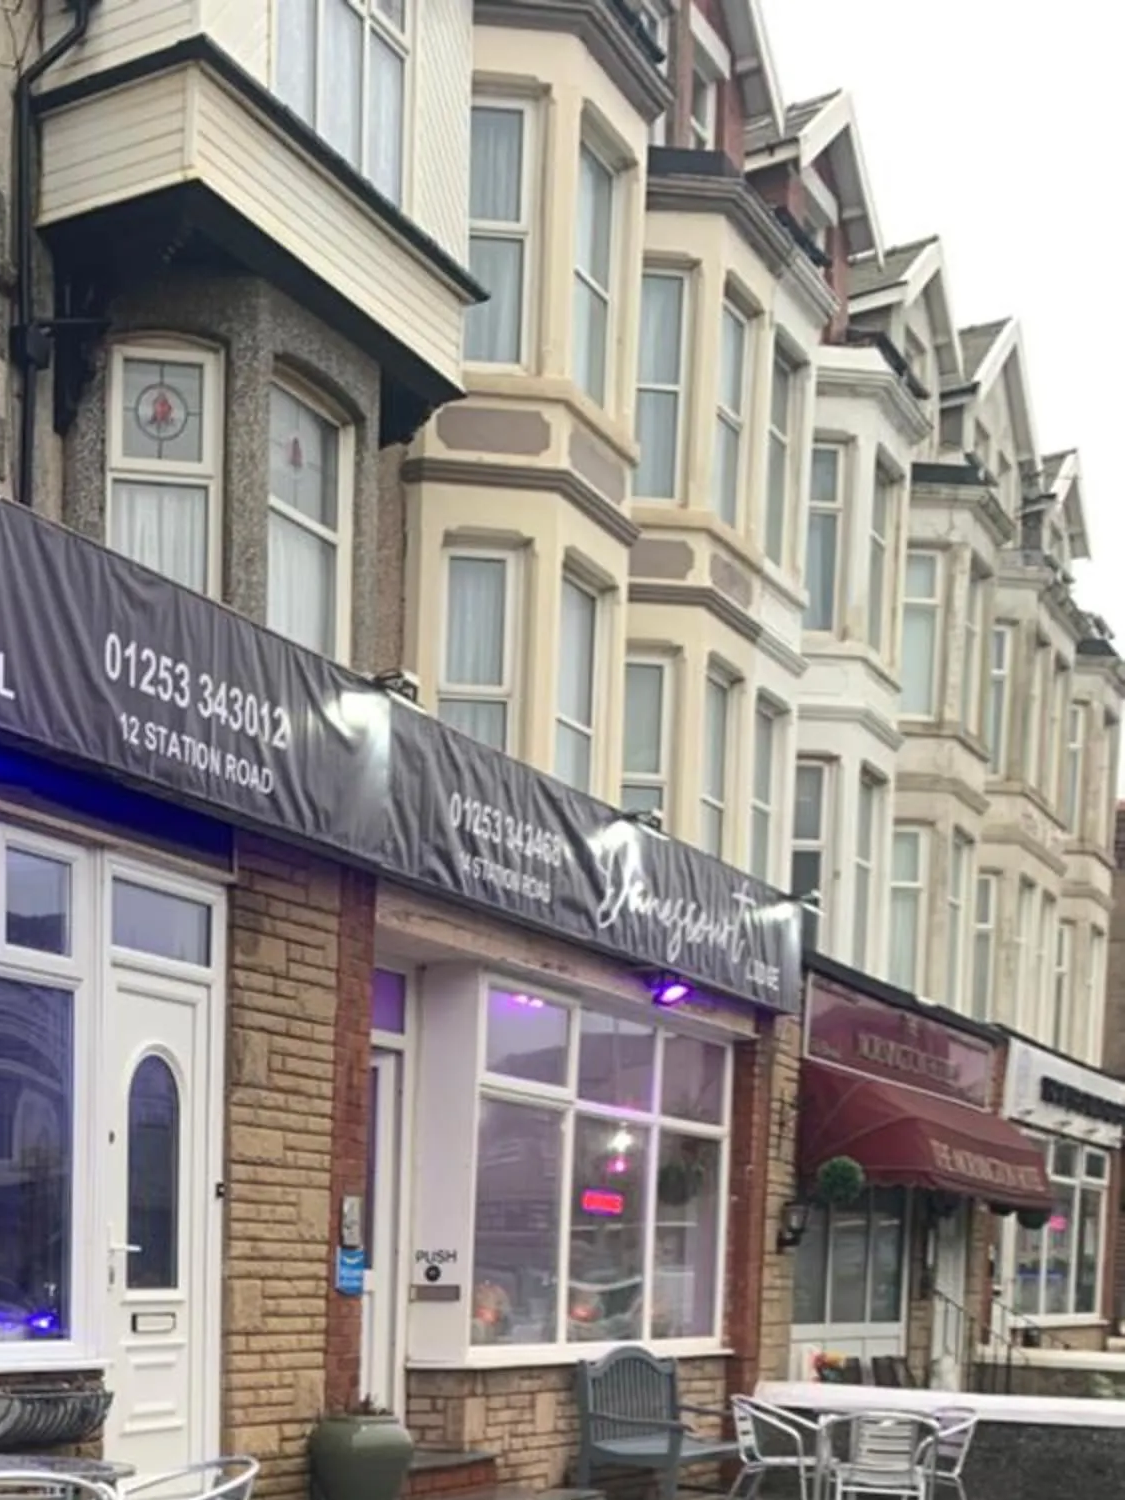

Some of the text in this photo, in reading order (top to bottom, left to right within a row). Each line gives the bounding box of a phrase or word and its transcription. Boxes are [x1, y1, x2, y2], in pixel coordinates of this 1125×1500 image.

[104, 632, 291, 750] 01253 343012
[120, 711, 274, 795] 12 STATION ROAD
[450, 791, 502, 844] 01253
[414, 1249, 458, 1265] PUSH
